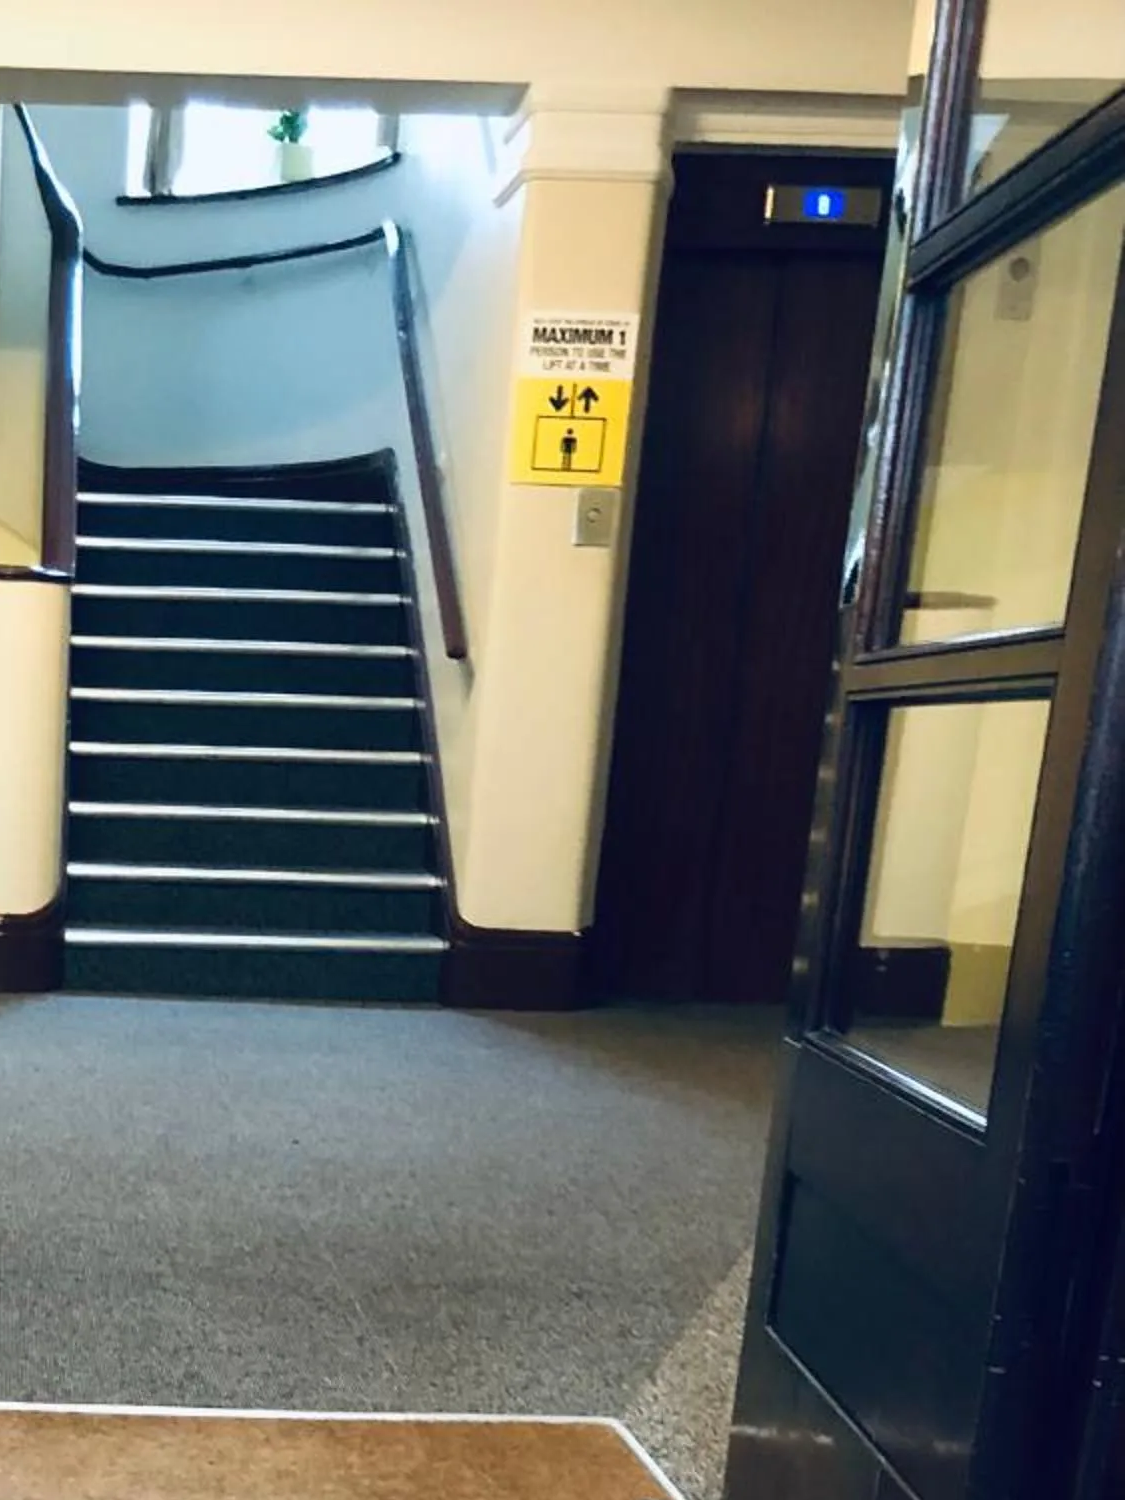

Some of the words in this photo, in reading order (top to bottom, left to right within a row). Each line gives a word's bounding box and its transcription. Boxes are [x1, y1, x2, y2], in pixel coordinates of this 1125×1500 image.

[532, 327, 613, 345] MAXIMUM
[619, 330, 626, 345] 1
[530, 346, 569, 358] PERSON
